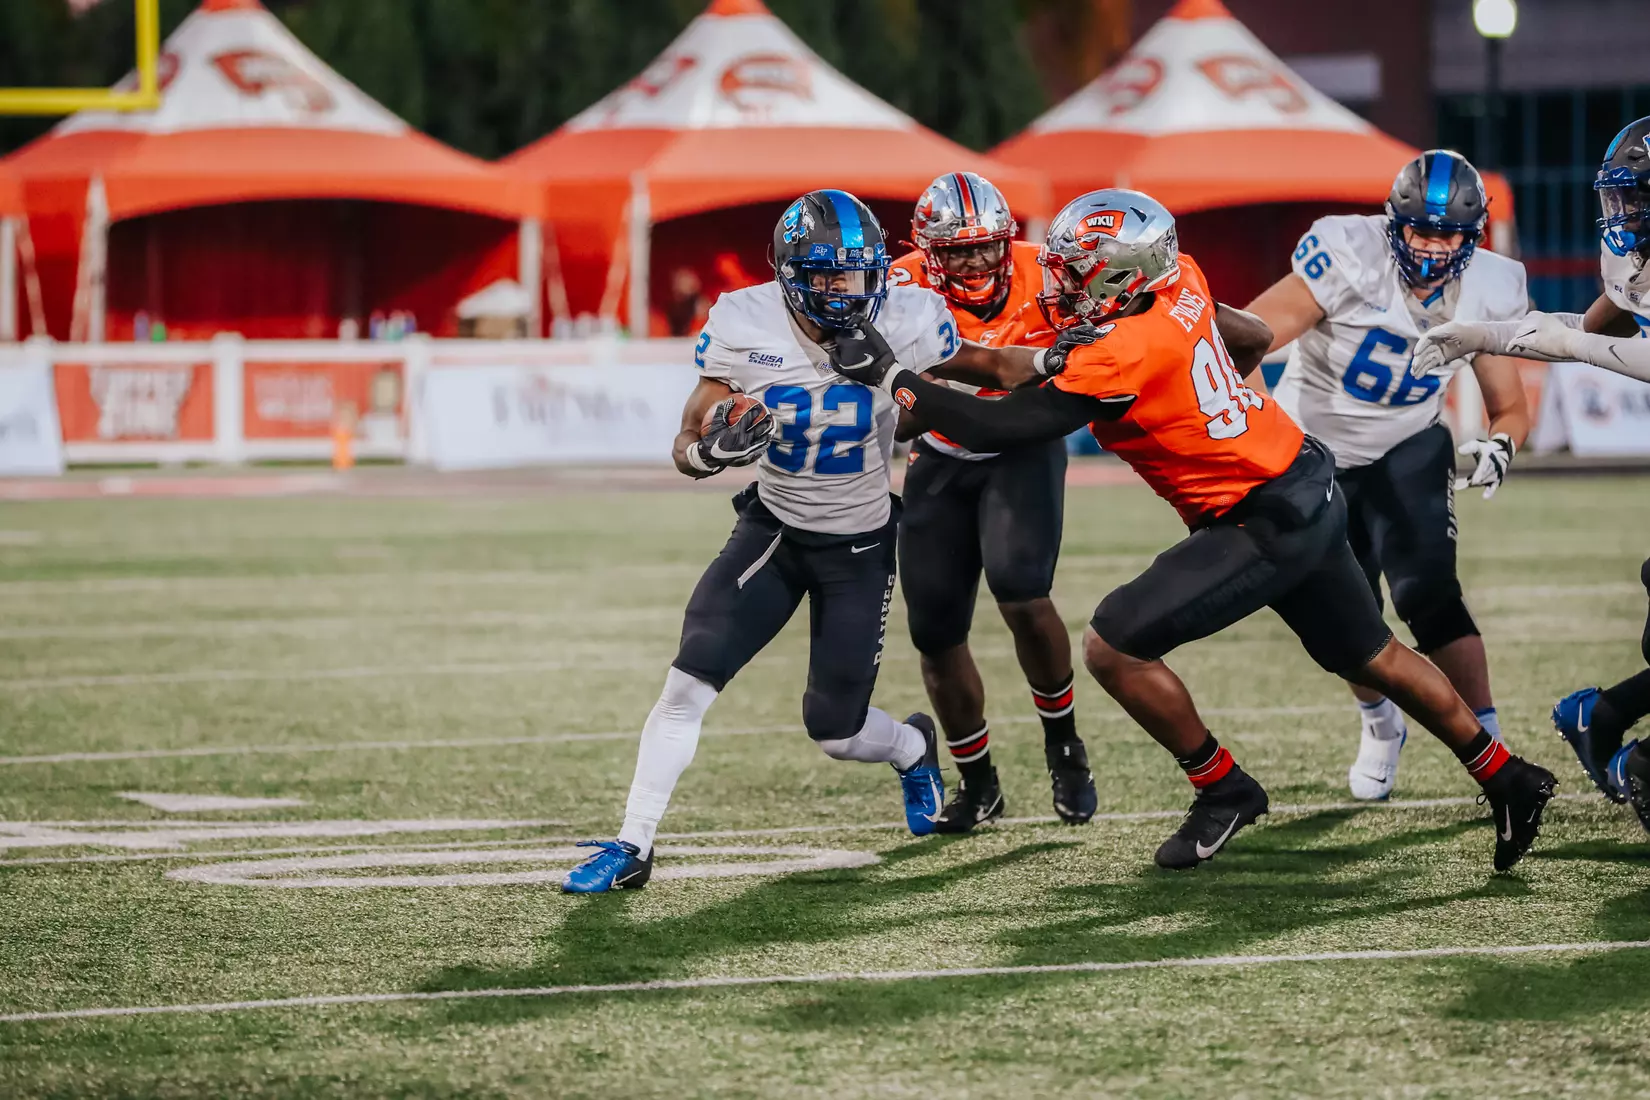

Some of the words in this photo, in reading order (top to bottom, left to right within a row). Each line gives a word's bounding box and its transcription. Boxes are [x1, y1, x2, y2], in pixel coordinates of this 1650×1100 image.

[1086, 215, 1114, 228] WKU
[1294, 235, 1332, 280] 66
[1169, 287, 1207, 333] EVANS
[748, 352, 784, 365] C-USA
[1342, 327, 1441, 407] 66
[763, 384, 877, 475] 32
